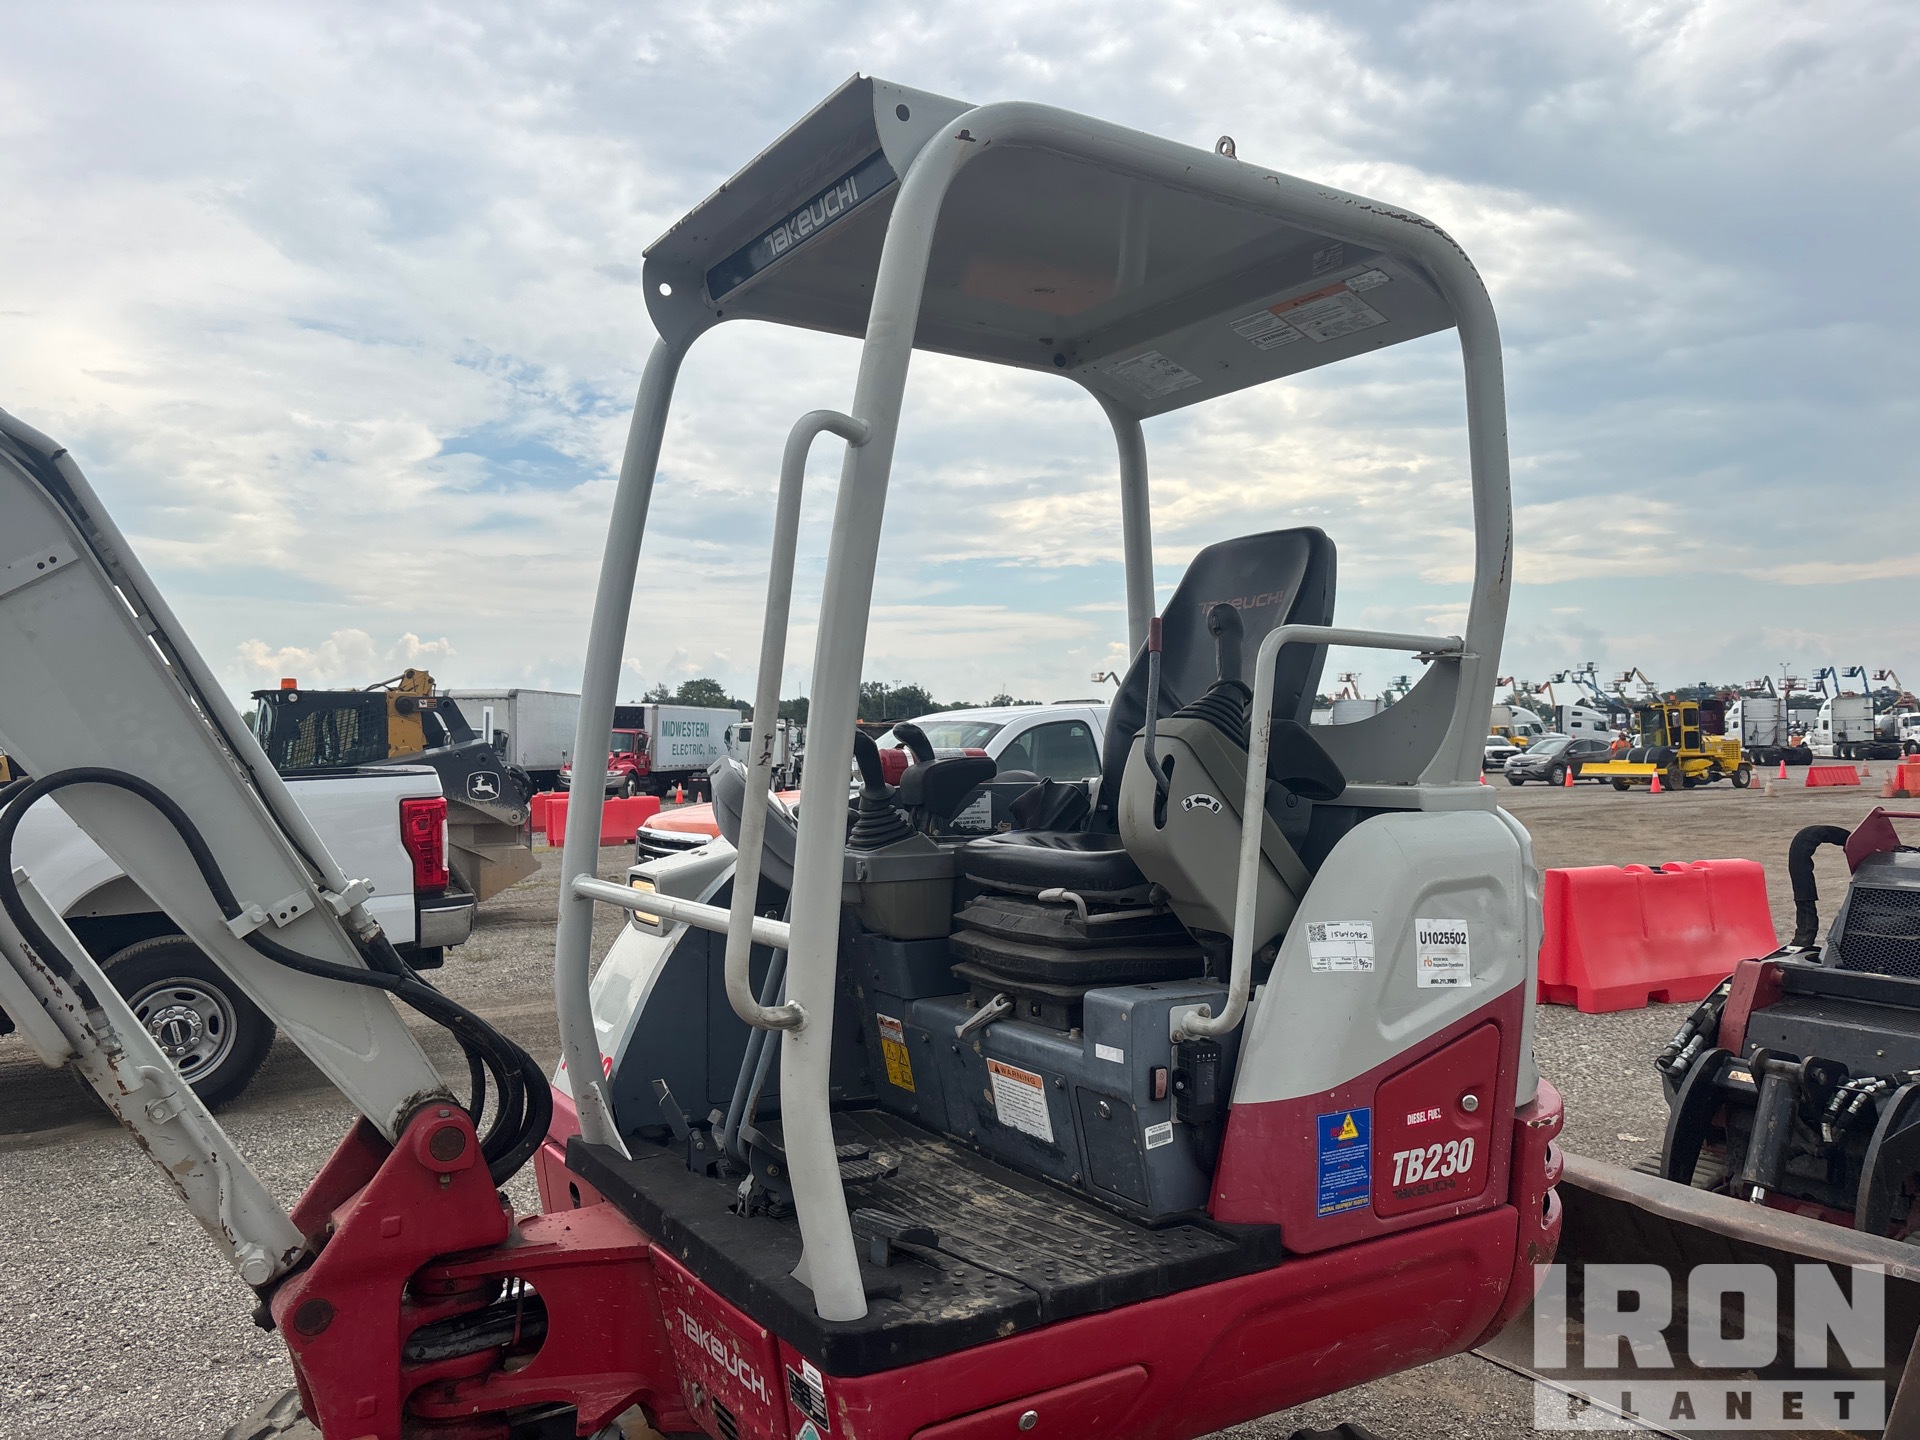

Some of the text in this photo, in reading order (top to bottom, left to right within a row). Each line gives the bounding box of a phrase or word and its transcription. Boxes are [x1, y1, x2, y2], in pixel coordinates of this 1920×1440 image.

[661, 720, 710, 737] MIDWESTERN
[671, 743, 705, 756] ELECTRIC,
[1420, 931, 1467, 945] U1025502
[1001, 1069, 1036, 1085] WARNING
[1407, 1107, 1442, 1126] DIESEL FUEL
[1392, 1137, 1475, 1187] TB230
